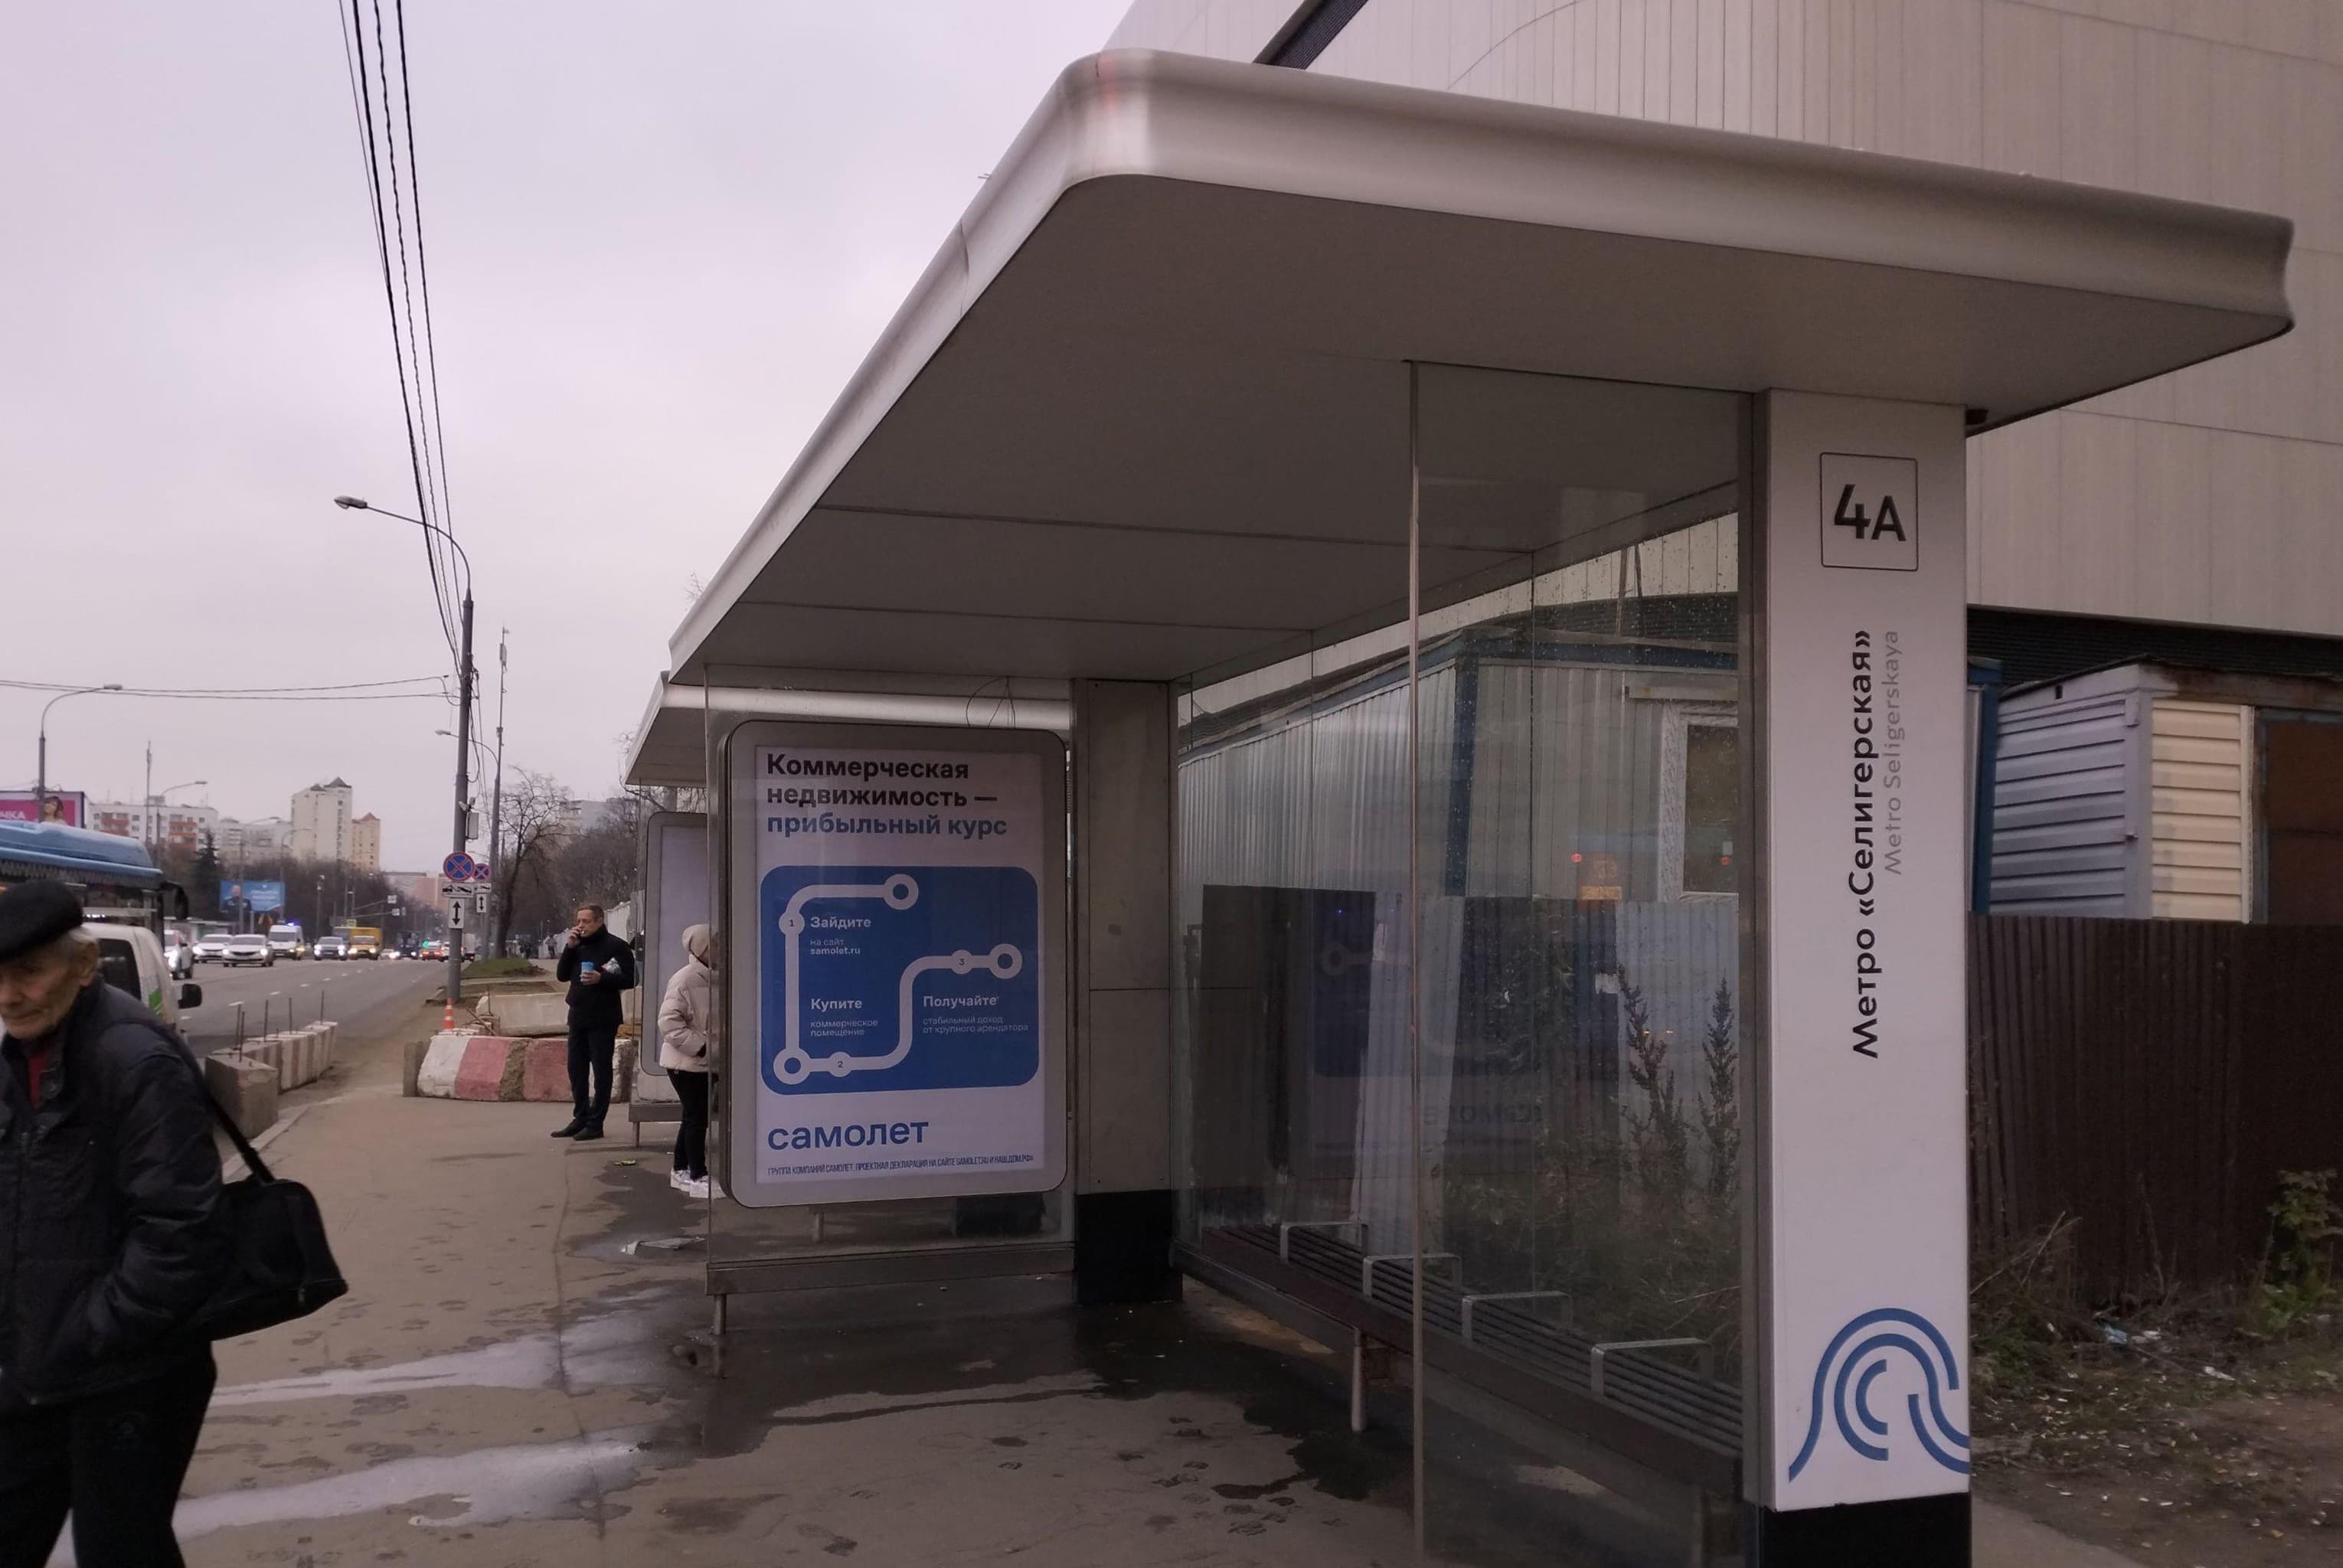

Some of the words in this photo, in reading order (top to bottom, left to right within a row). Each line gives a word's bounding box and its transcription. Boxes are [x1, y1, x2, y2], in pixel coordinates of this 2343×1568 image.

[1881, 631, 1905, 789] Seligerskaya
[767, 753, 969, 782] Коммерческая
[1848, 630, 1879, 916] «Селигерская»
[767, 787, 968, 808] недвижимость
[767, 812, 941, 838] прибыльный
[949, 818, 1008, 839] курс
[1884, 797, 1901, 875] Metro
[810, 916, 871, 930] Зайдите
[810, 946, 861, 956] samolet.ru
[811, 998, 862, 1012] Купите
[1852, 928, 1882, 1059] Метро
[810, 1019, 878, 1028] коммерческое
[923, 1016, 975, 1024] стабильный
[935, 1025, 975, 1034] крупного
[768, 1122, 929, 1150] самолет
